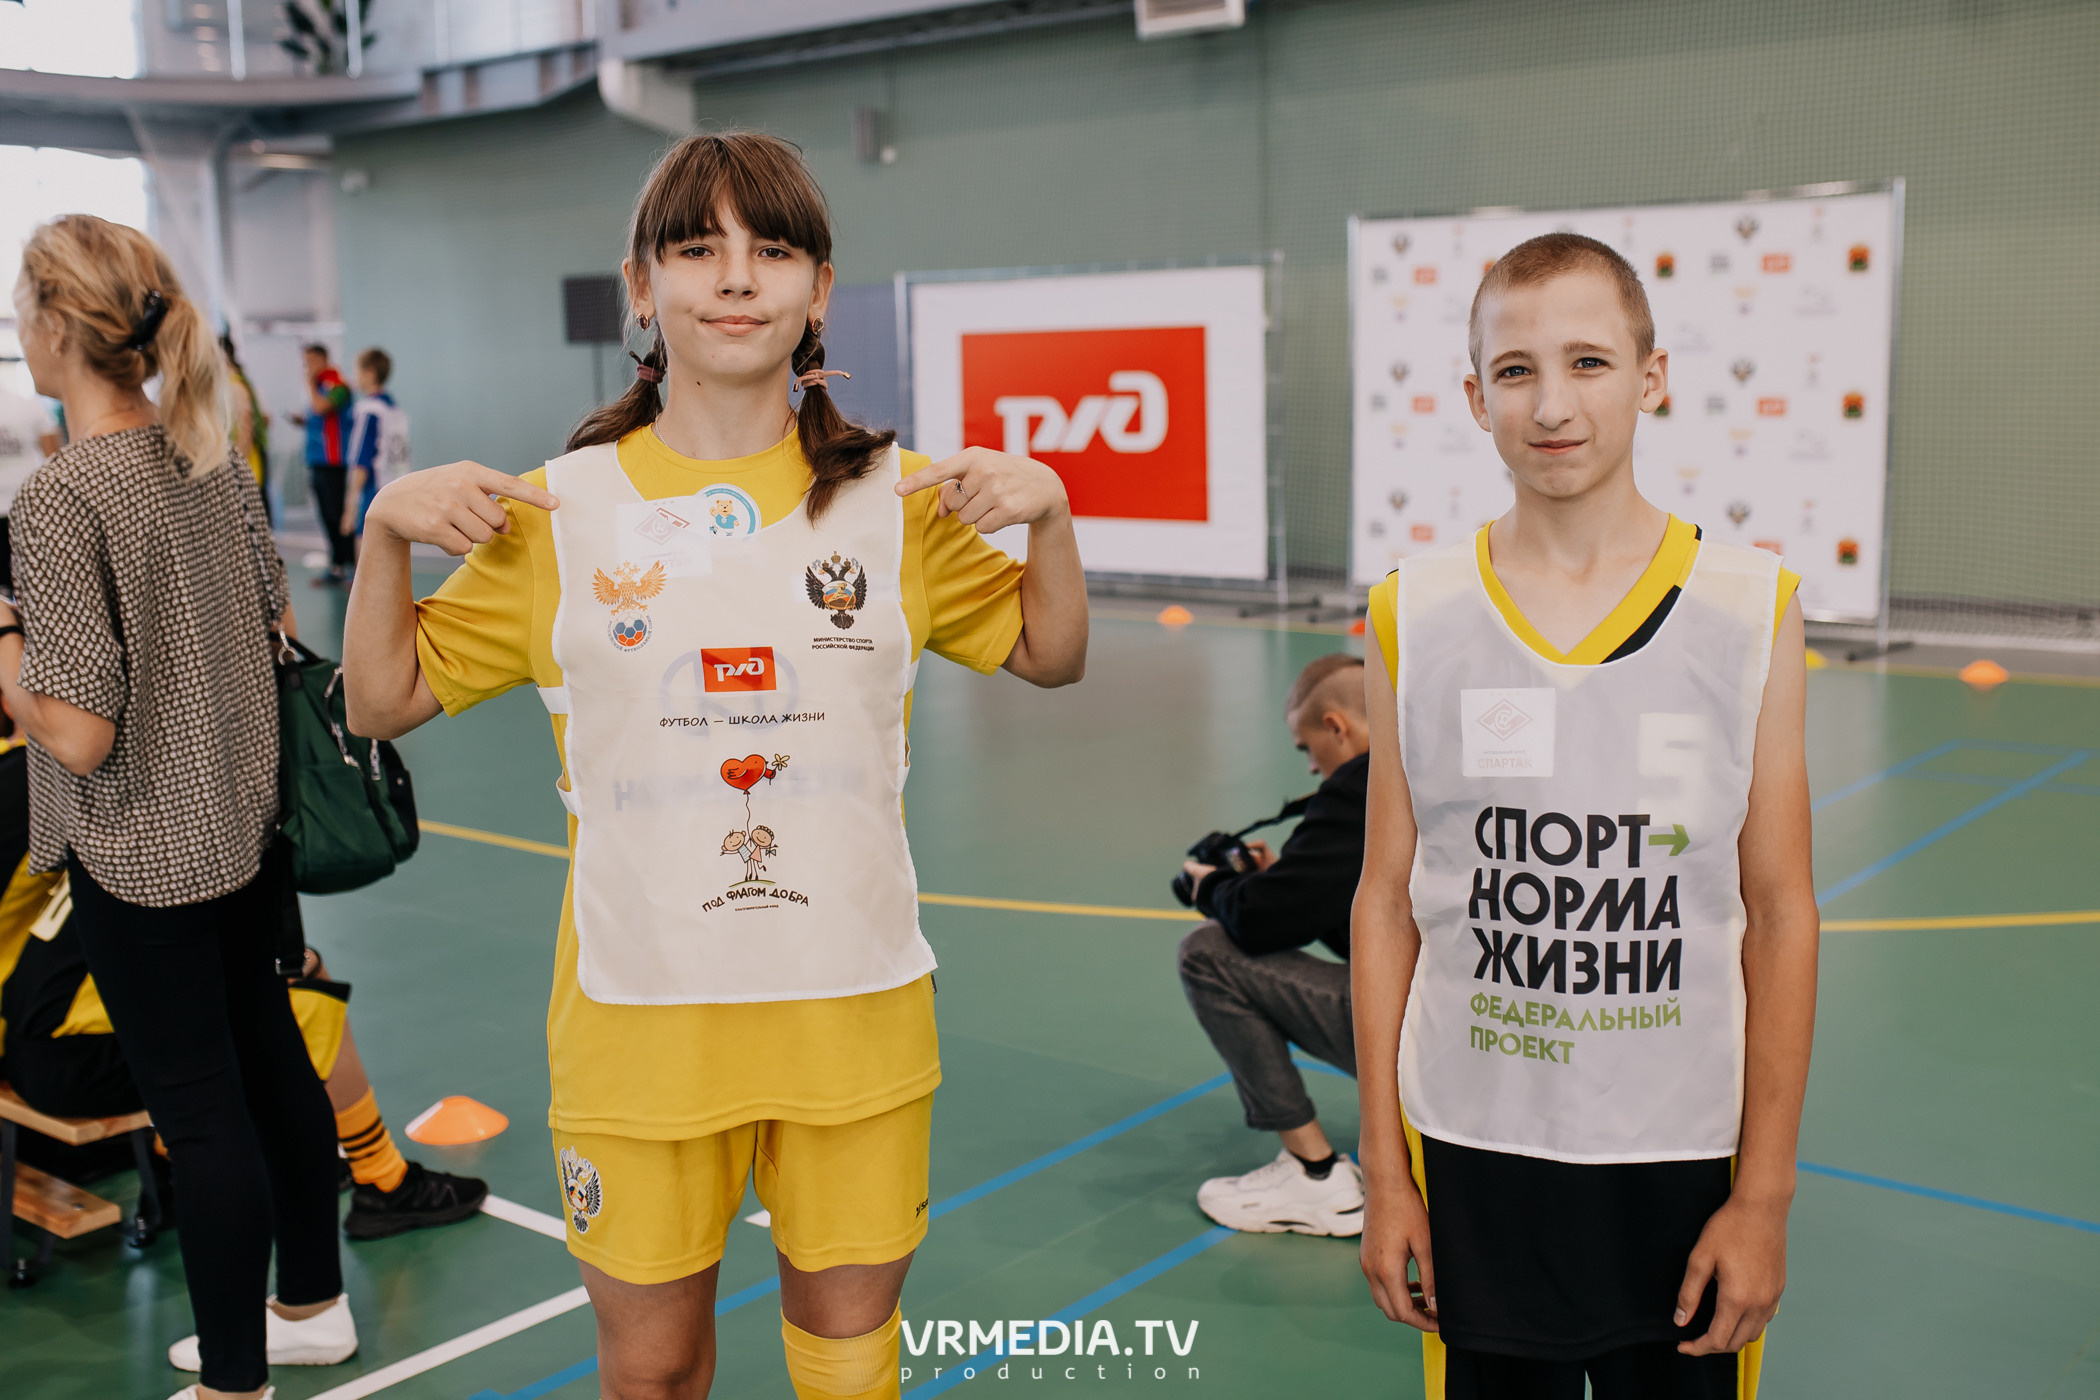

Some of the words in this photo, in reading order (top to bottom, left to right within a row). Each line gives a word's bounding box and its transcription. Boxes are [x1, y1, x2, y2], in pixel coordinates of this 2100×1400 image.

[659, 717, 709, 728] ФУТБОЛ
[728, 714, 778, 726] ШКОЛА
[781, 712, 826, 724] ЖИЗНИ
[1477, 758, 1534, 769] СПАРТАК
[1475, 806, 1651, 869] СПОРТ
[702, 896, 726, 913] ПОД
[726, 887, 767, 901] ФЛАГОМ
[768, 888, 810, 908] ДОБРА
[1468, 867, 1681, 933] НОРМА
[1471, 927, 1683, 995] ЖИЗНИ
[1470, 992, 1682, 1032] ФЕДЕРАЛЬНЫЙ
[1470, 1025, 1575, 1065] ПРОЕКТ
